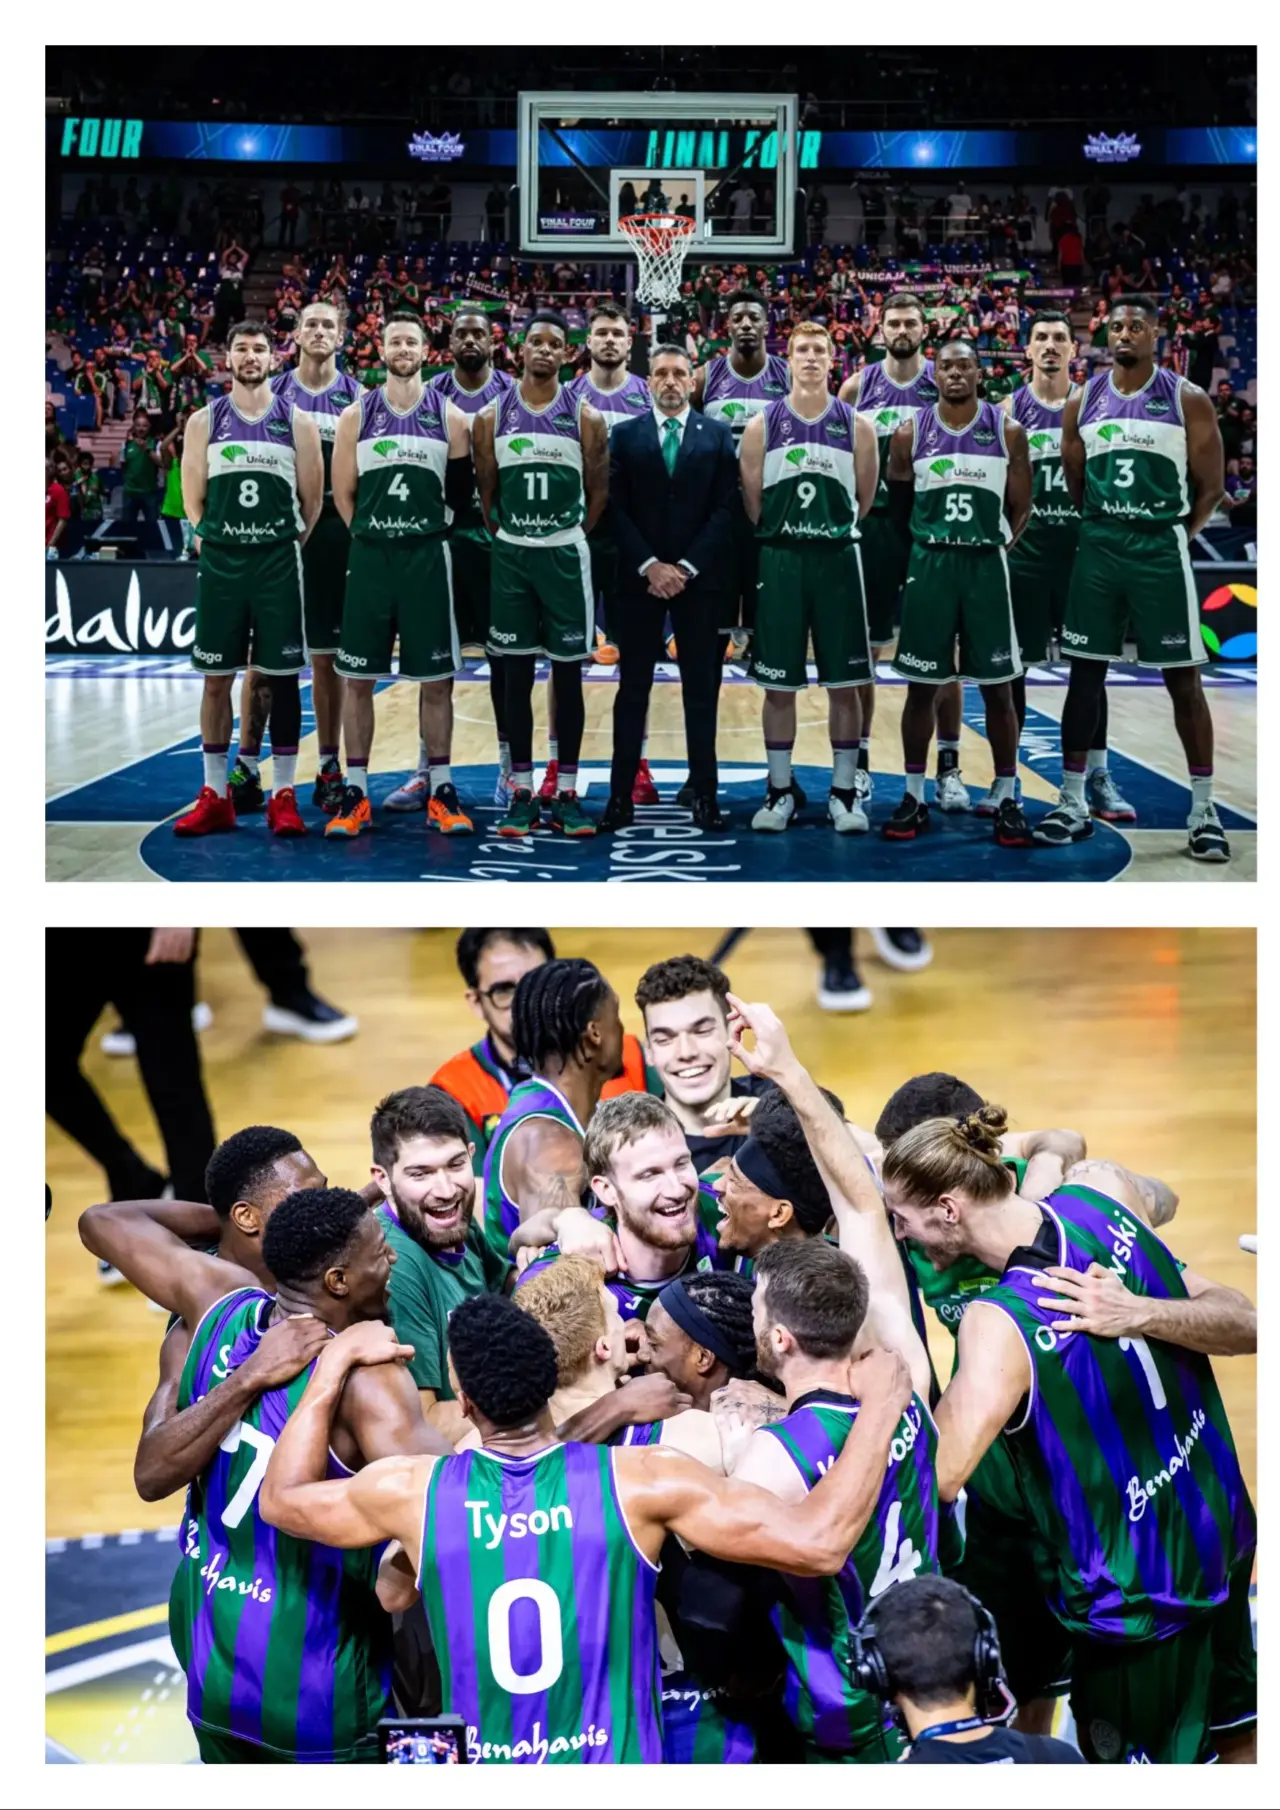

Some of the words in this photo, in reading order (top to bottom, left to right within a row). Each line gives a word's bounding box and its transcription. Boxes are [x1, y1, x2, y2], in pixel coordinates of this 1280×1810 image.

[60, 117, 144, 159] FOUR
[1122, 432, 1156, 446] Unicaja
[246, 454, 278, 466] Unicaja
[397, 449, 428, 460] Unicaja
[387, 472, 410, 501] 4
[523, 472, 548, 500] 11
[953, 468, 986, 480] Unicaja
[1042, 464, 1069, 492] 14
[1113, 458, 1135, 488] 3
[239, 479, 260, 508] 8
[797, 480, 817, 508] 9
[944, 492, 973, 522] 55
[1118, 1333, 1167, 1410] 1
[220, 1420, 277, 1528] 7
[464, 1500, 573, 1550] Tyson
[869, 1501, 922, 1597] 4
[488, 1577, 563, 1695] 0
